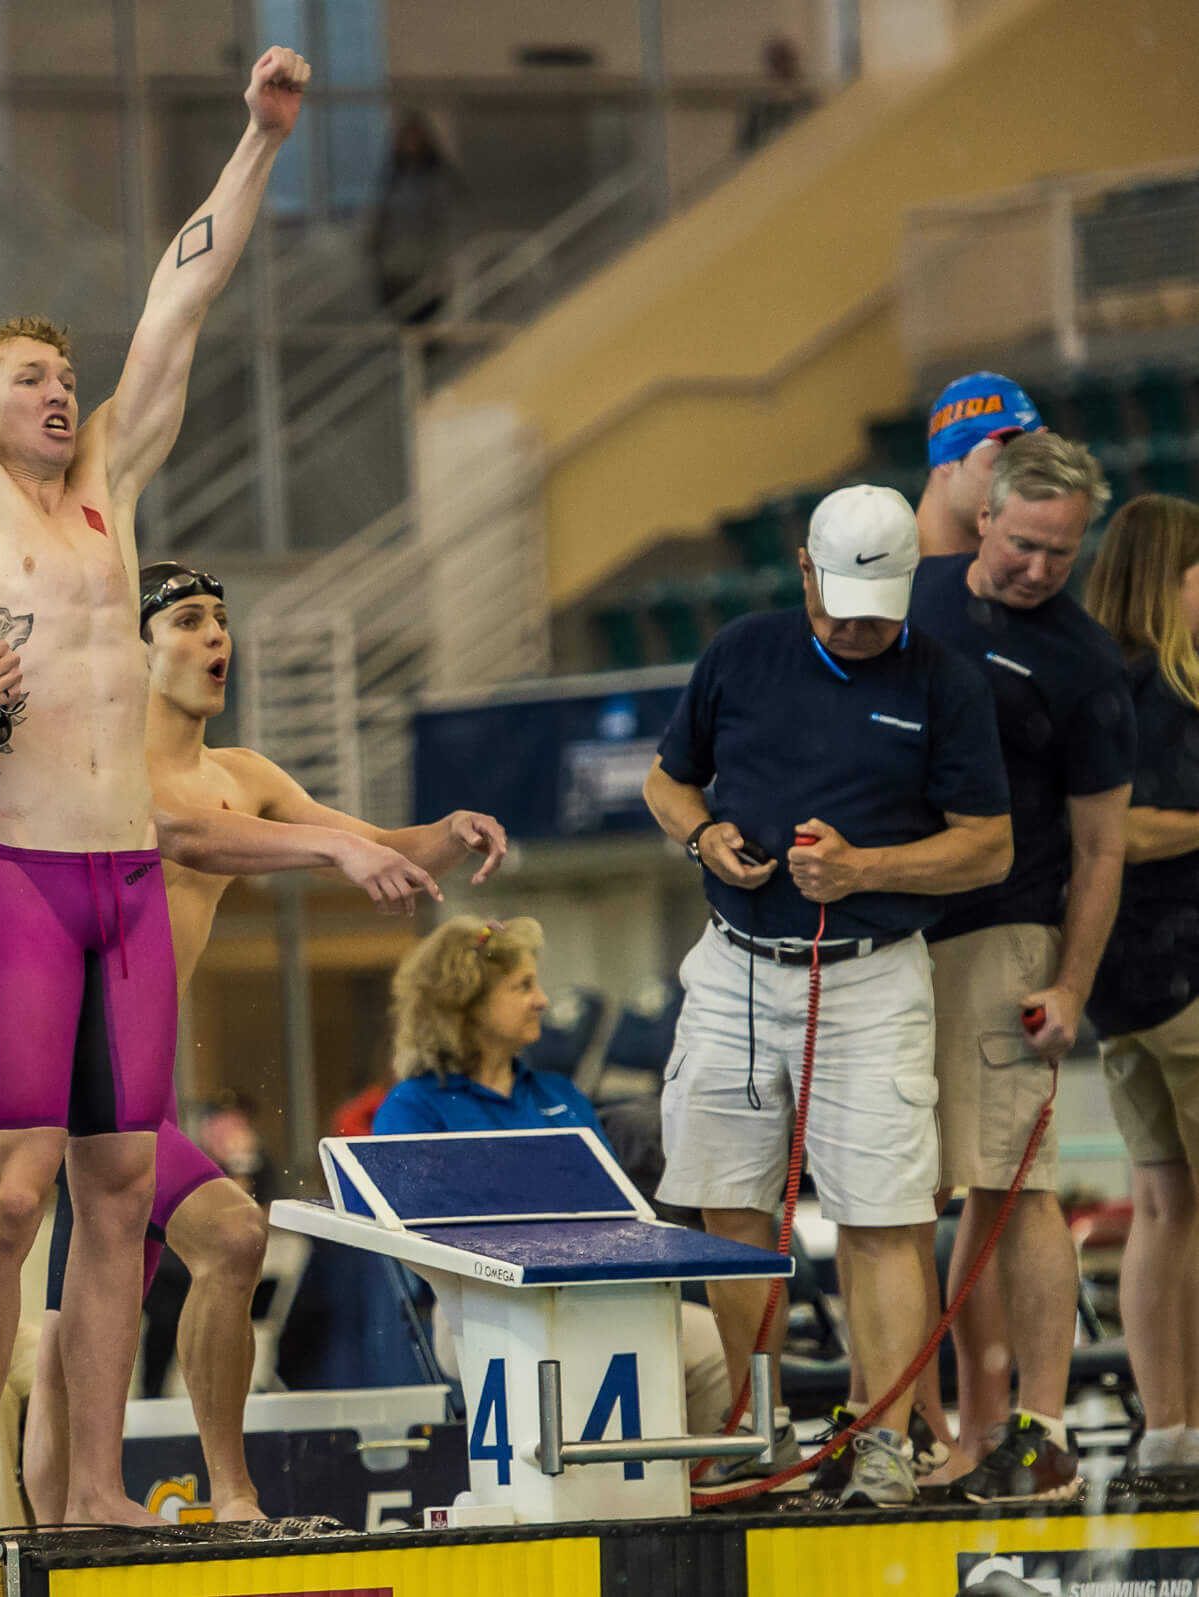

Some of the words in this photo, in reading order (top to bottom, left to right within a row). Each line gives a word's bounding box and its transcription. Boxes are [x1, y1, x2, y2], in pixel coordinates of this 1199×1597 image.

[484, 1265, 515, 1282] OMEGA
[469, 1358, 513, 1485] 4
[580, 1352, 645, 1481] 4
[1069, 1580, 1156, 1597] SWIMMING
[1158, 1579, 1193, 1597] AND
